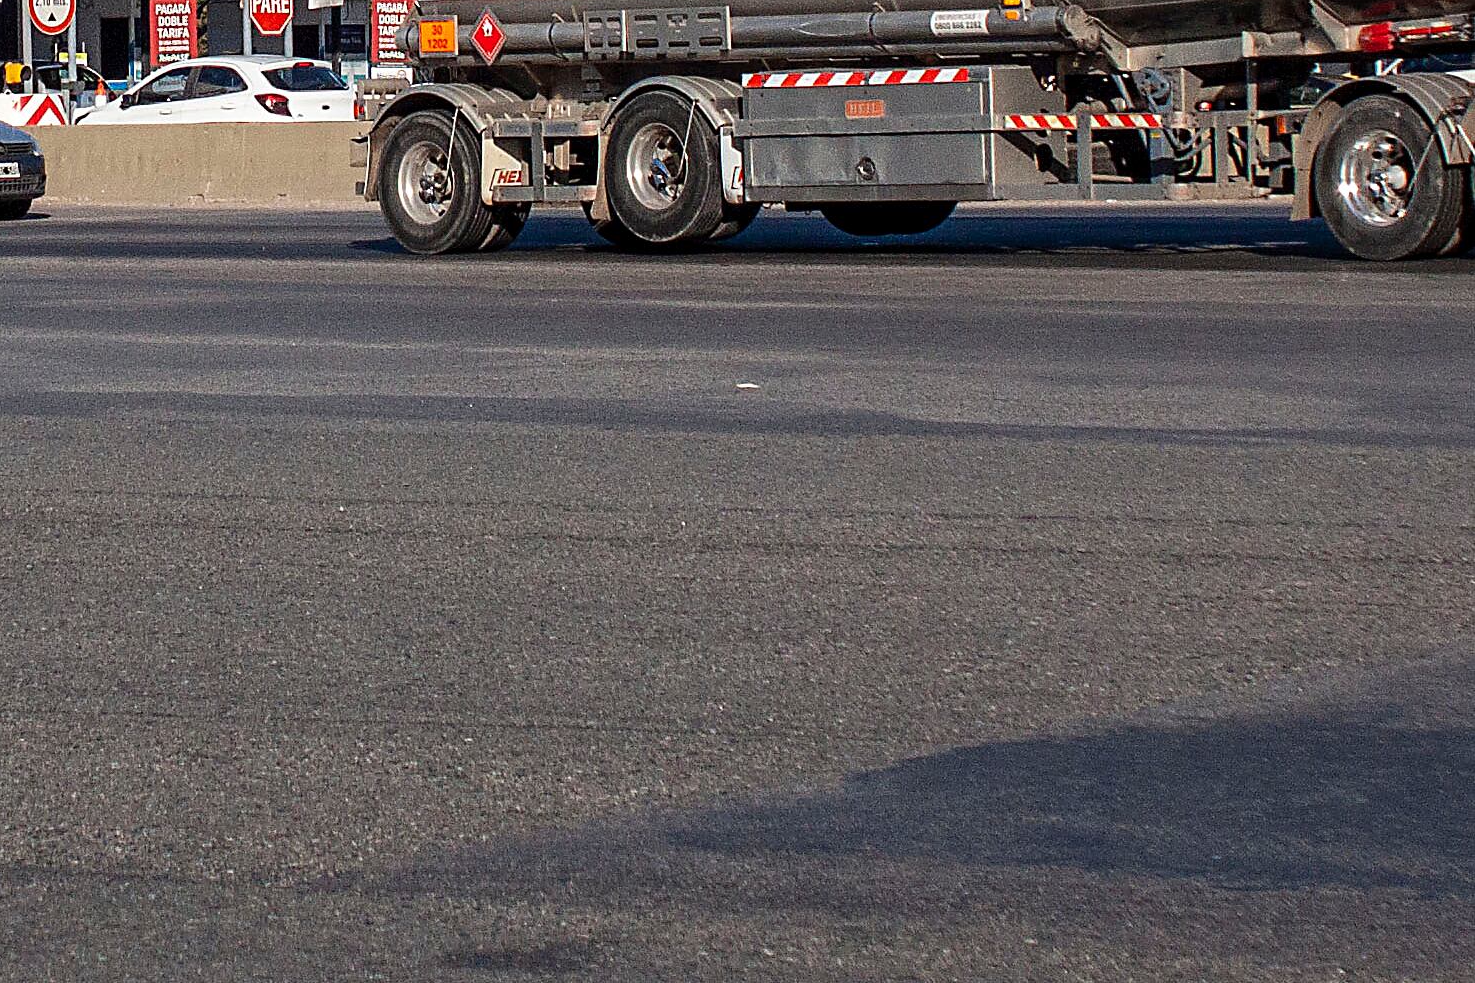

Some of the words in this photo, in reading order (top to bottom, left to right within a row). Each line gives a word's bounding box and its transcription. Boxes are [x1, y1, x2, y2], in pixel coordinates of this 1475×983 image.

[155, 0, 191, 15] PAGARÁ
[377, 0, 408, 13] PAGARÁ
[158, 16, 188, 27] DOBLE
[157, 28, 189, 39] TARIFA
[432, 24, 442, 35] 30
[427, 39, 448, 49] 1202
